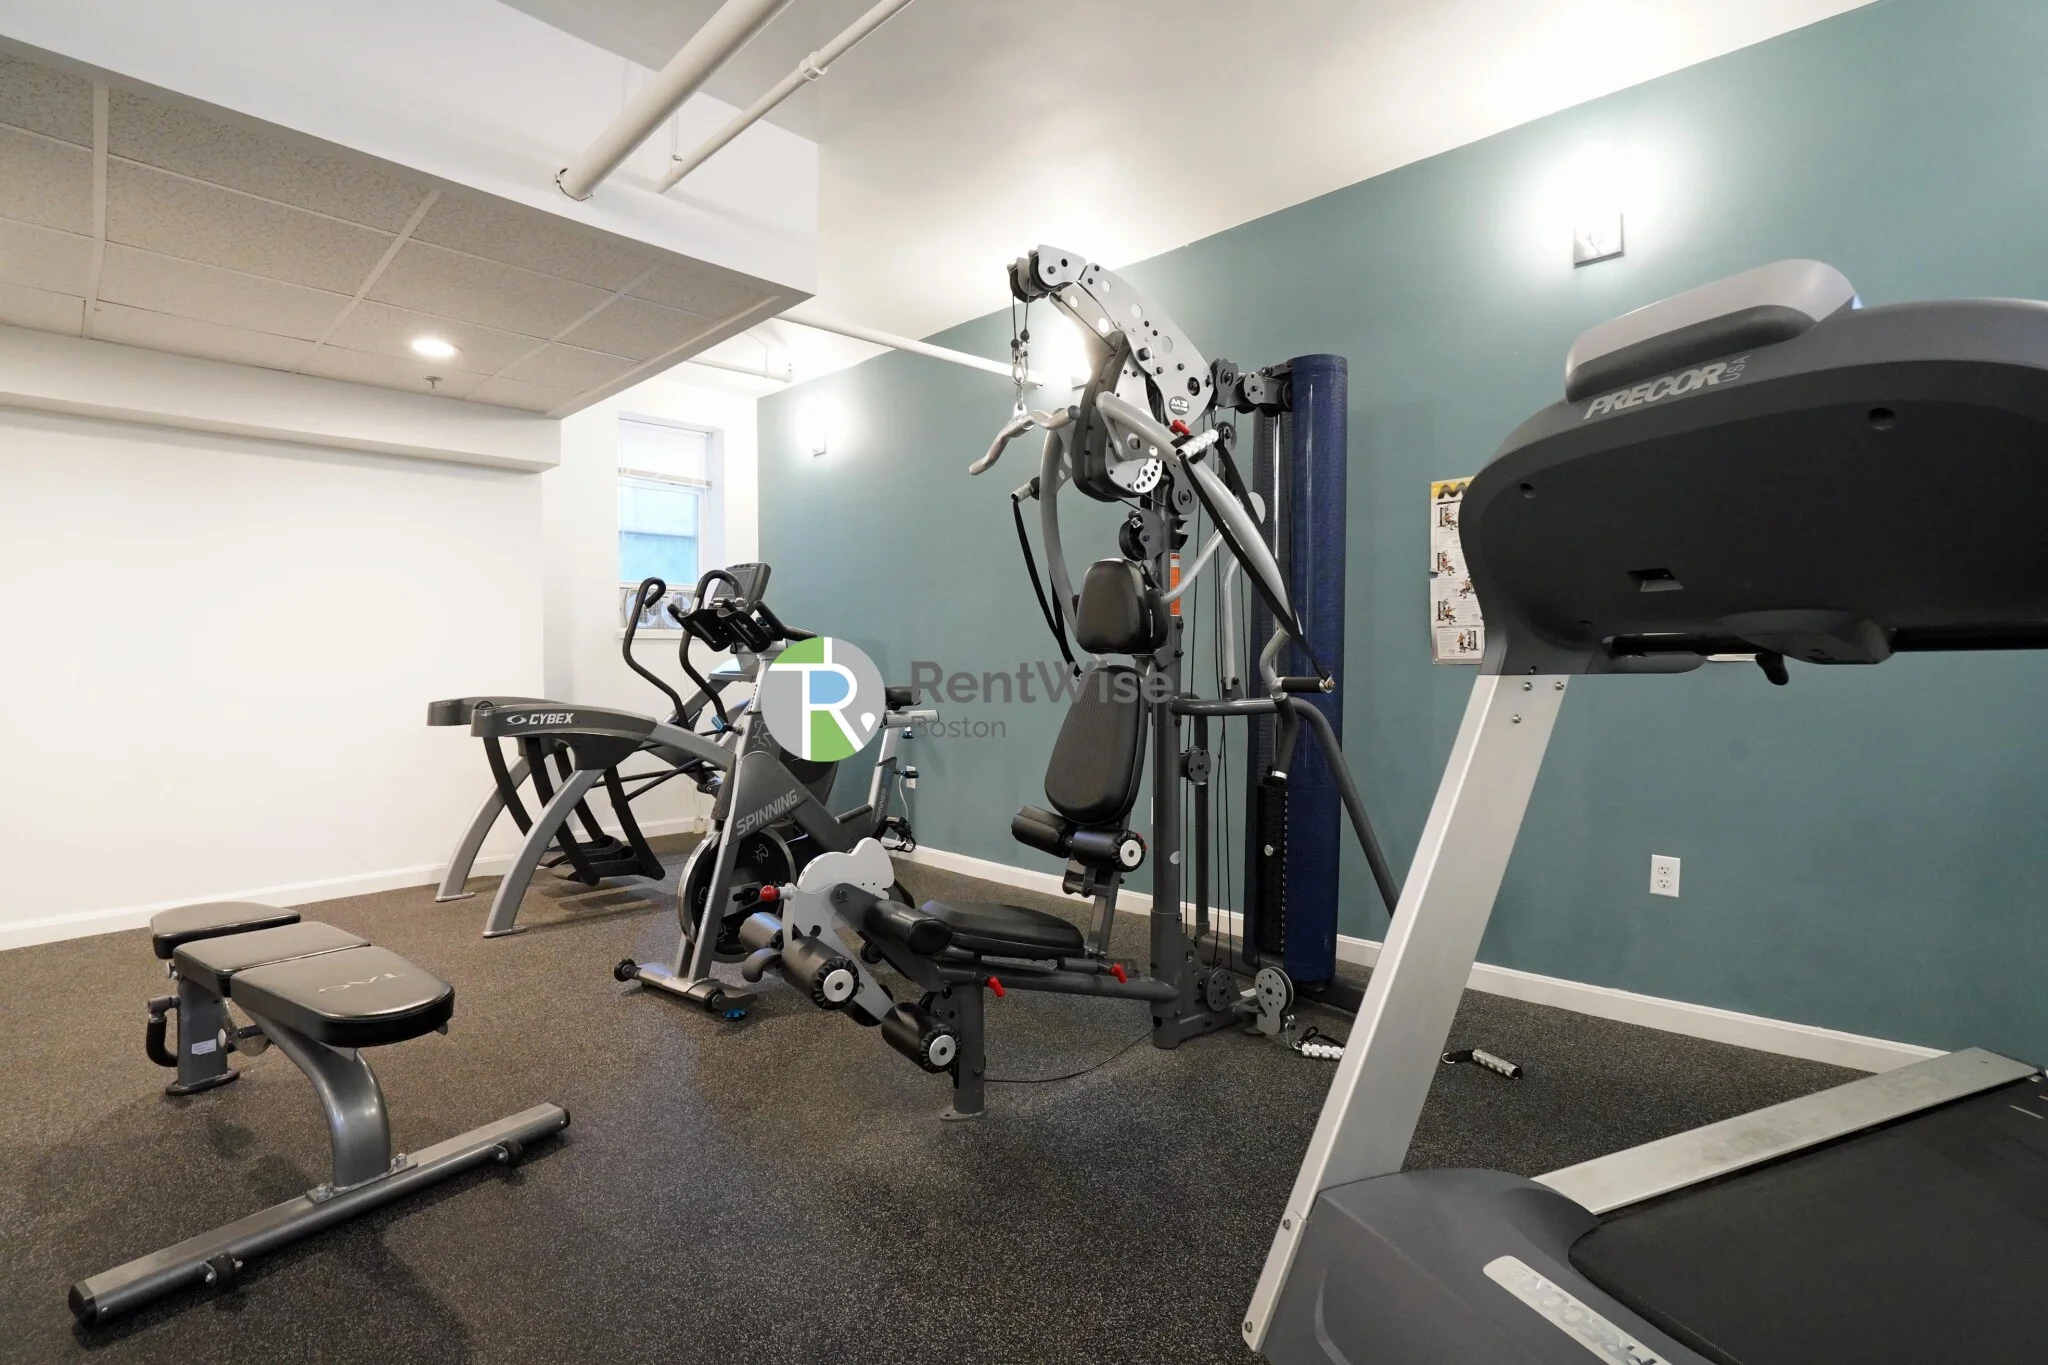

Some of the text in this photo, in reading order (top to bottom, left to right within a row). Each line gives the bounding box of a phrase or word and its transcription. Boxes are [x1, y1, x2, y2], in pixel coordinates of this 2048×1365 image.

[1583, 355, 1750, 420] PRECOR USA
[528, 712, 575, 725] CYBEX
[736, 788, 798, 836] SPINNING
